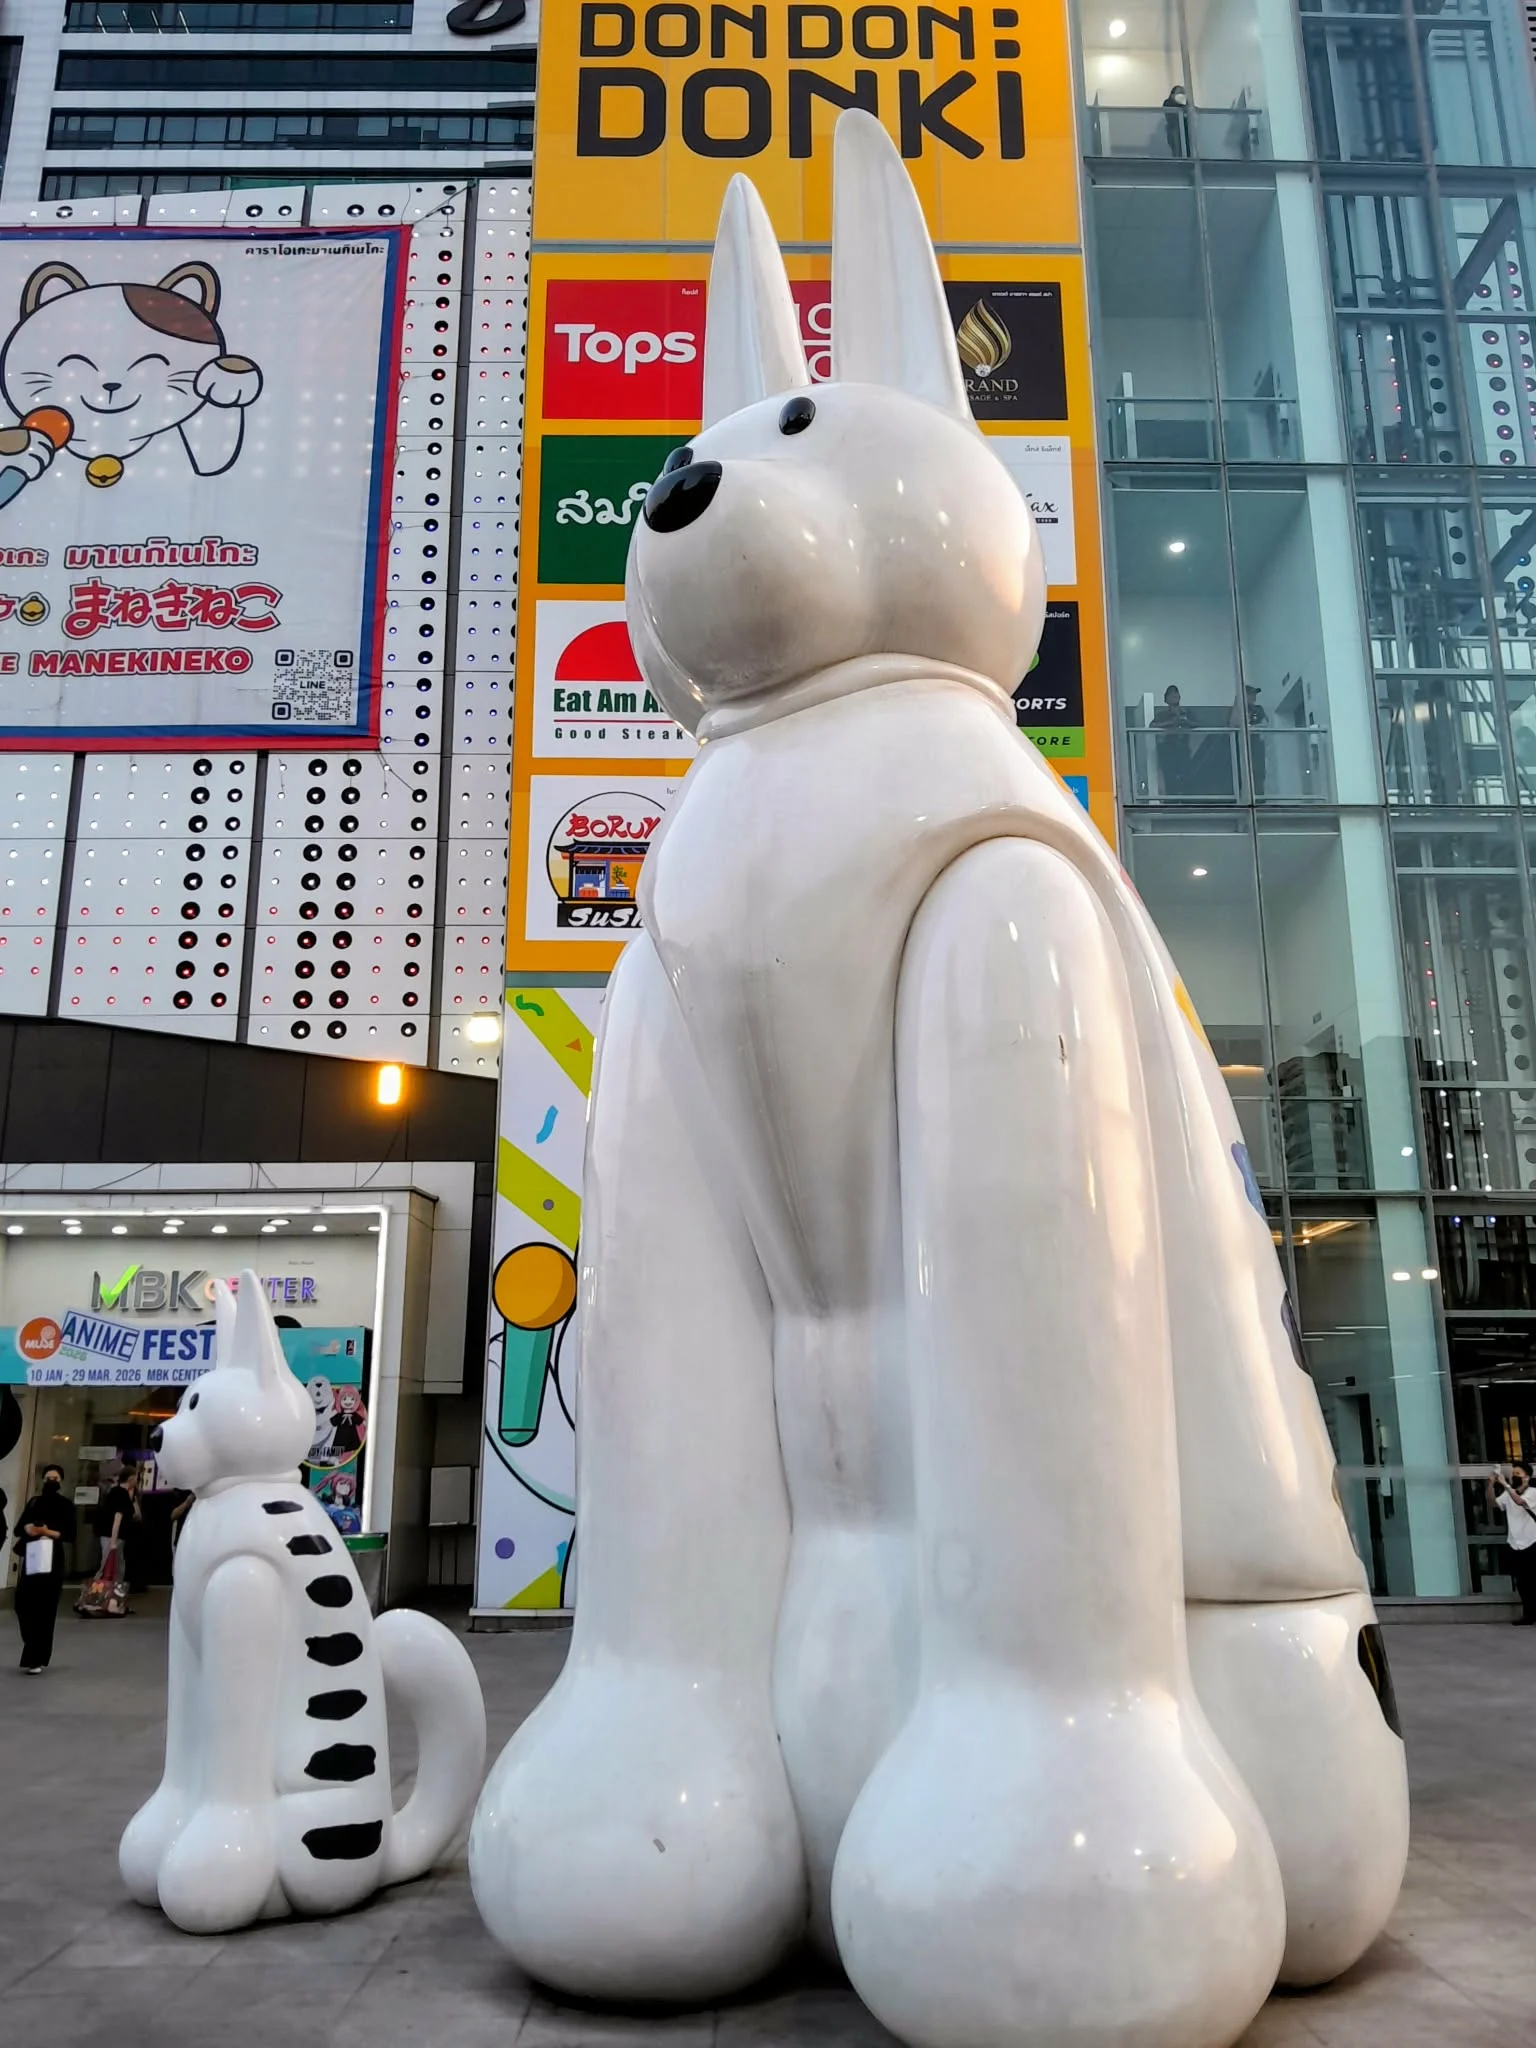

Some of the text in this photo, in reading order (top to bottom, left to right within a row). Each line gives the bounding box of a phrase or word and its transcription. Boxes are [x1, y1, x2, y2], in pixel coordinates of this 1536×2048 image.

[580, 3, 767, 59] DON
[576, 67, 1026, 159] DONKI
[554, 323, 697, 374] Tops
[964, 378, 1019, 392] RAND
[65, 538, 257, 568] มาเนกิเนโกะ
[63, 578, 281, 638] まねきねこ
[30, 649, 252, 675] MANEKINEKO
[300, 681, 325, 689] LINE
[553, 688, 664, 712] Eat Am A
[1015, 698, 1067, 710] ORTS
[555, 727, 683, 740] Good Steak
[91, 1265, 206, 1311] MBK
[62, 1316, 138, 1360] ANIME
[142, 1330, 216, 1361] FEST
[31, 1369, 42, 1381] 10
[45, 1369, 63, 1381] JAN
[72, 1369, 85, 1381] 29
[115, 1369, 141, 1381] 2026
[147, 1369, 169, 1381] MBK
